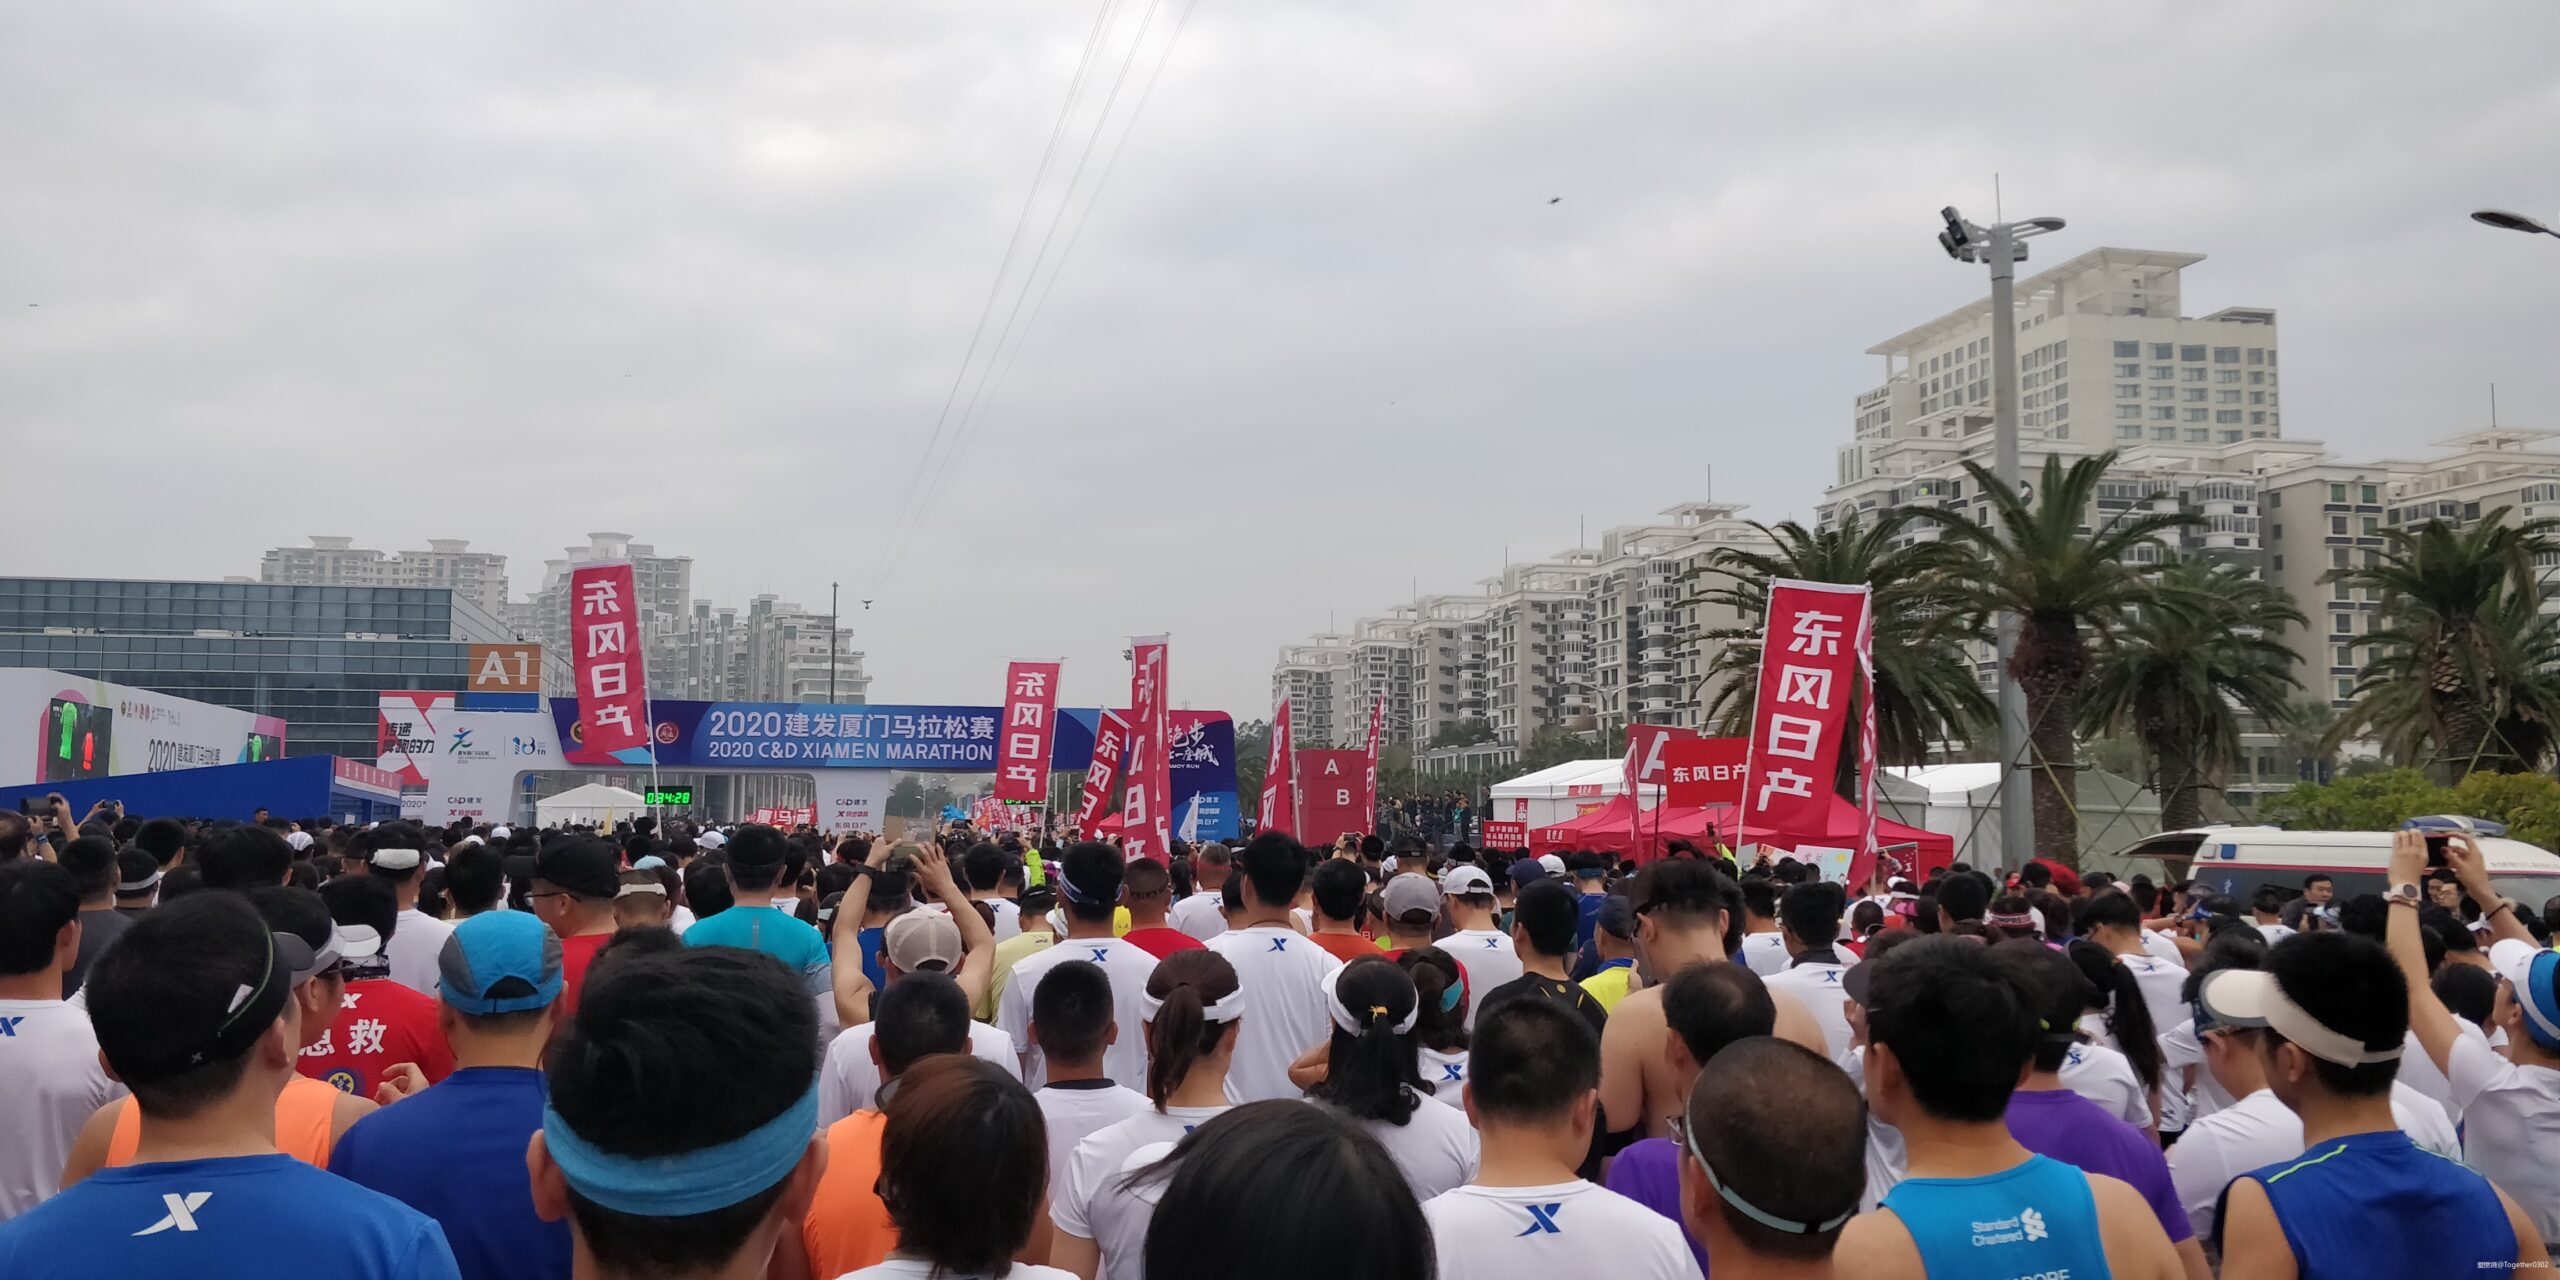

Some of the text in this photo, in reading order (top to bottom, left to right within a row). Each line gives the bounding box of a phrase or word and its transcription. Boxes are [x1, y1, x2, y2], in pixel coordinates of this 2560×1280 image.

[475, 650, 529, 685] A1
[1757, 609, 1843, 812] 东风日产
[385, 722, 413, 737] 传递
[709, 710, 995, 741] 2020建发厦门马拉松赛
[148, 739, 177, 773] 2020
[708, 741, 993, 762] 2020 C&D XIAMEN MARATHON
[1324, 758, 1340, 775] A
[1672, 763, 1747, 783] 东风日产
[1079, 730, 1120, 841] 东风日
[1336, 788, 1350, 805] B
[1971, 1217, 2020, 1233] Standard
[1972, 1230, 2024, 1247] Chartered
